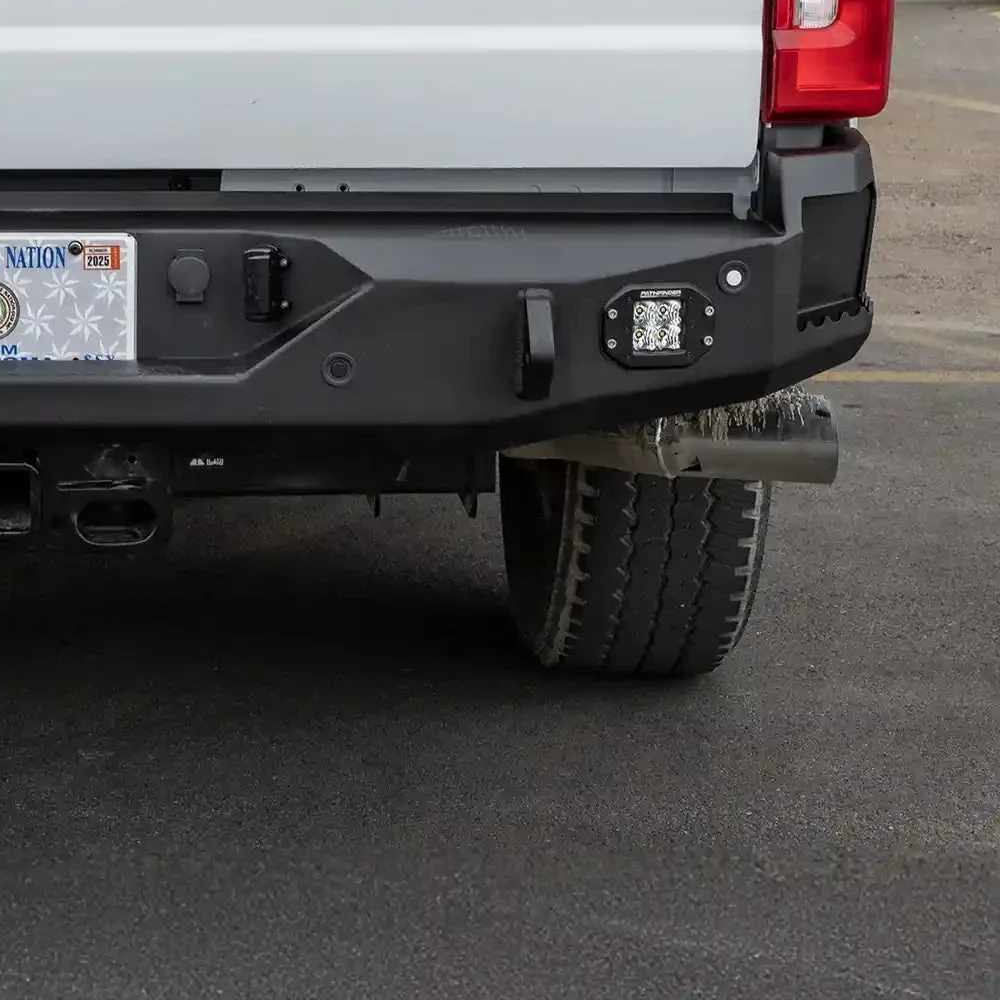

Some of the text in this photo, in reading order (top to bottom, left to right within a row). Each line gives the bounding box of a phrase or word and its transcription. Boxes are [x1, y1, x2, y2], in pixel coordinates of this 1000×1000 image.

[5, 245, 66, 268] NATION
[87, 255, 110, 266] 2025
[640, 290, 681, 298] PATHFINDER
